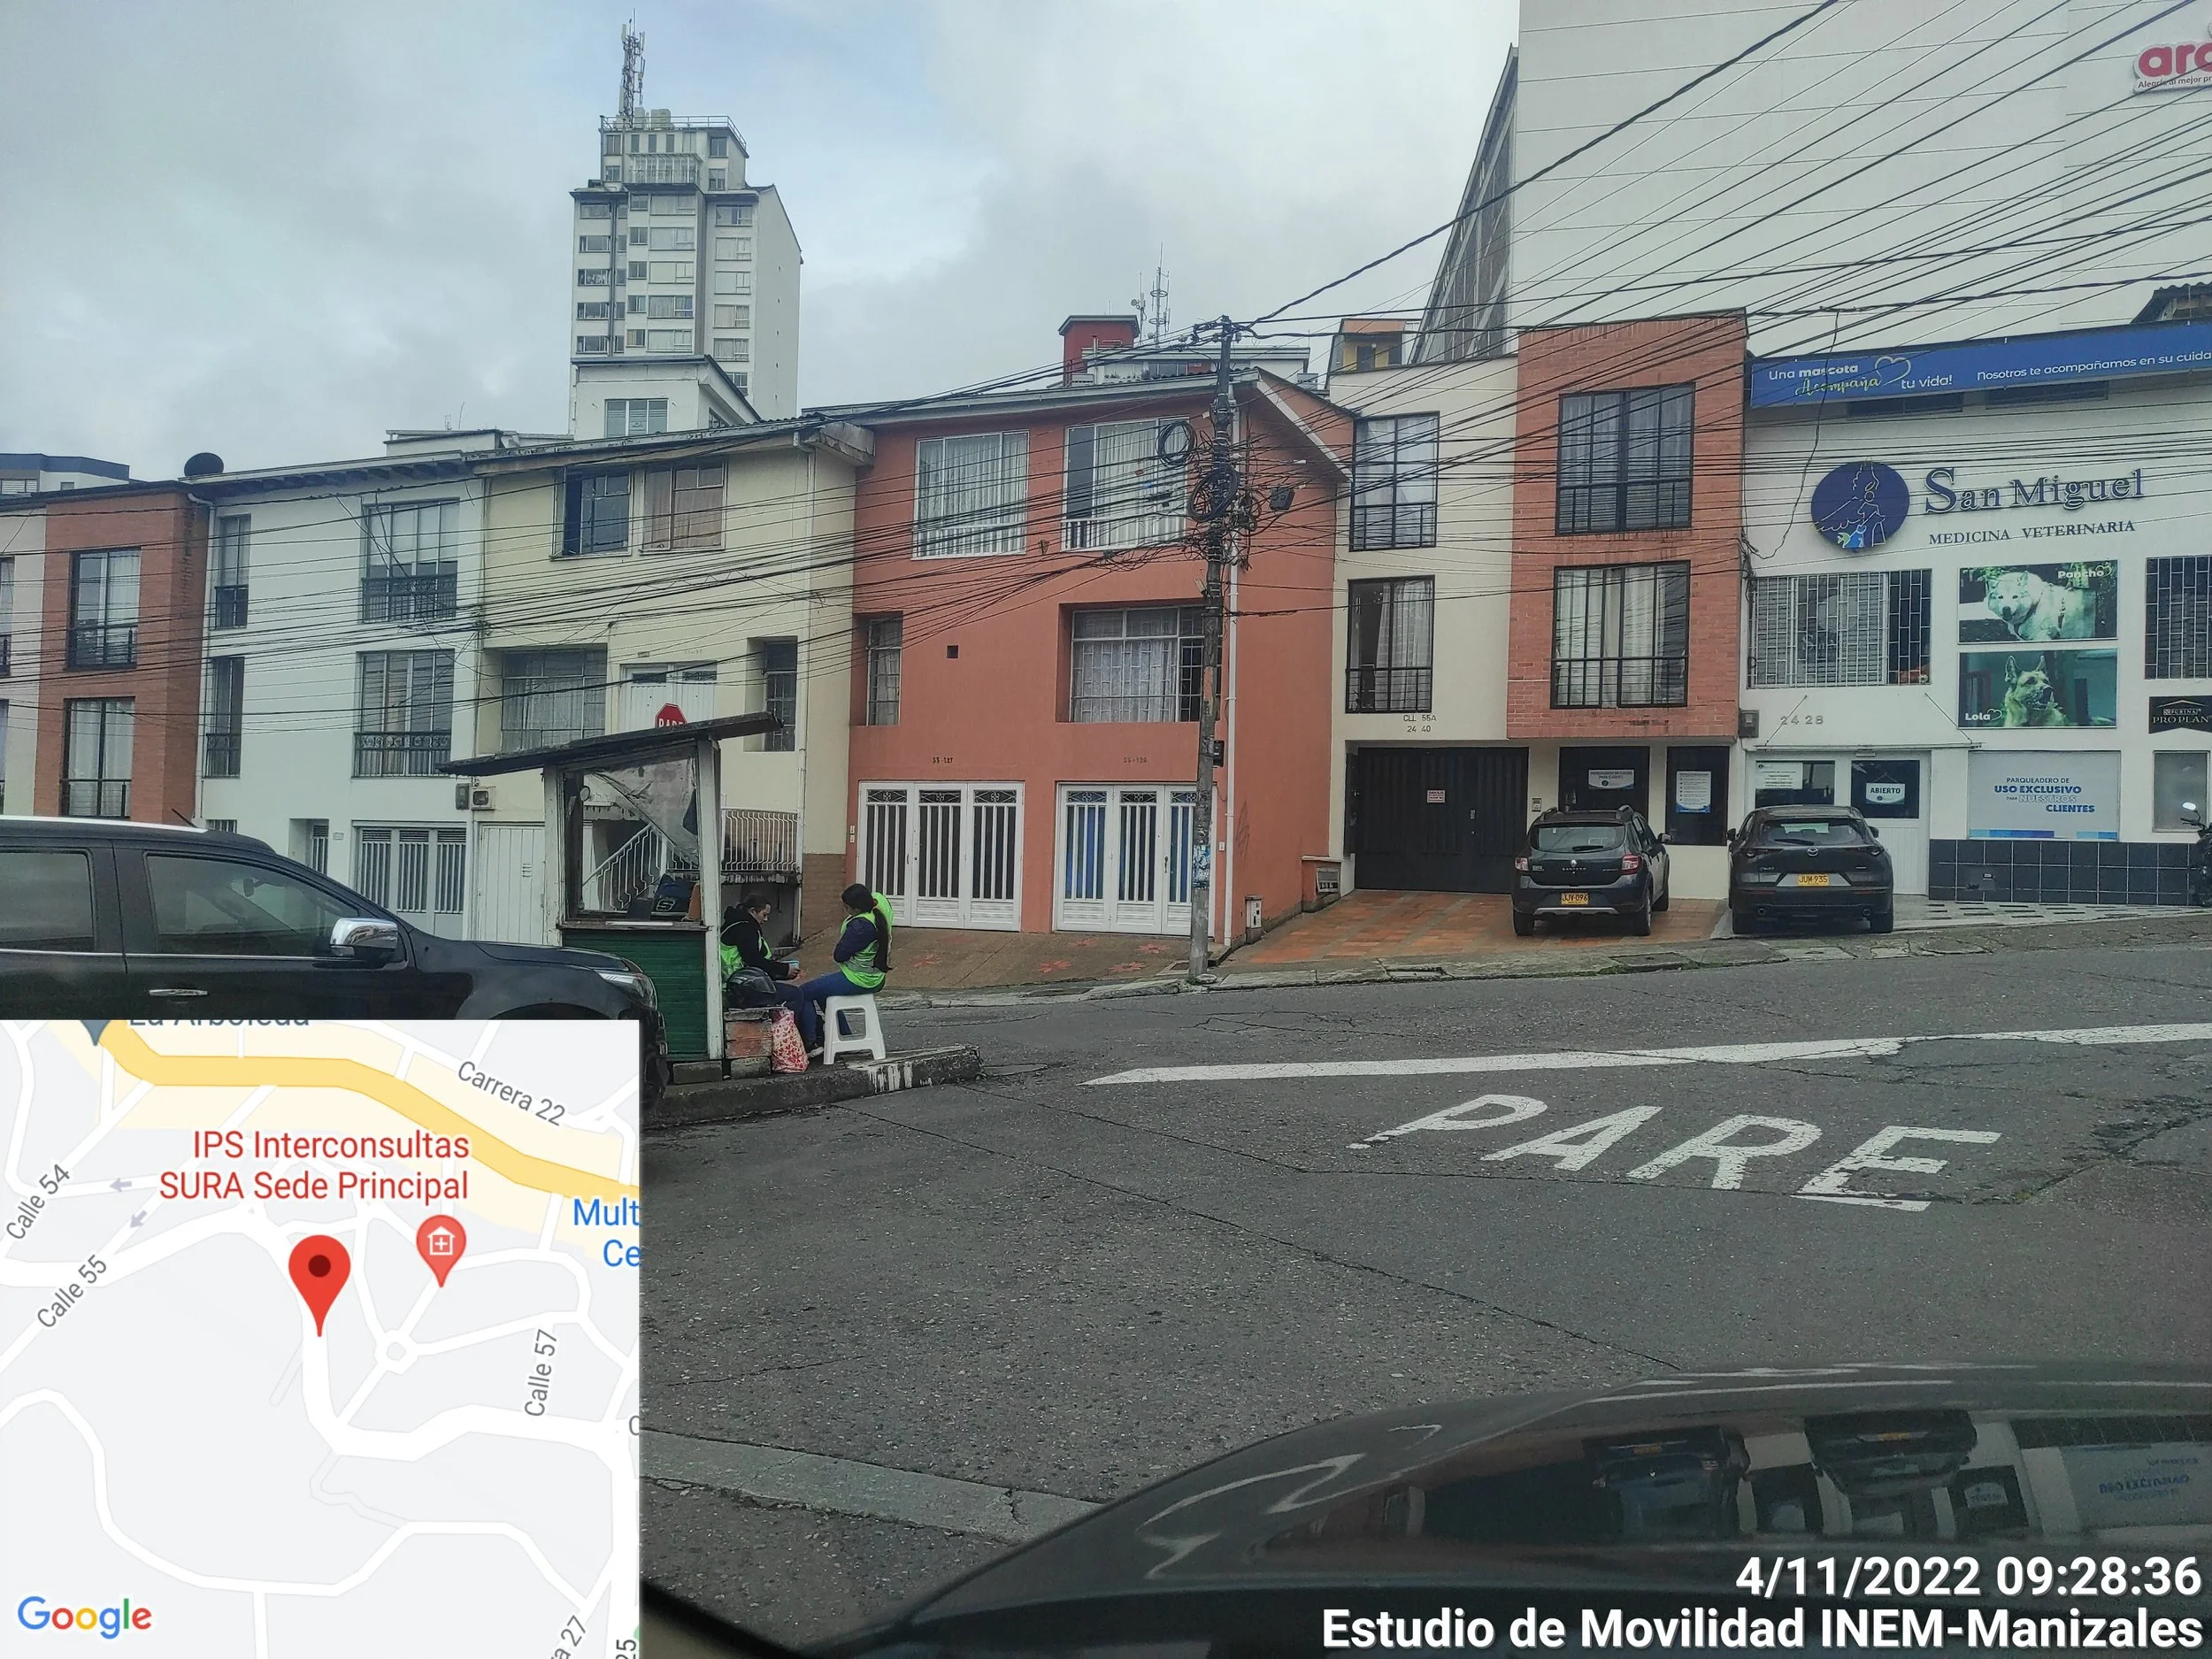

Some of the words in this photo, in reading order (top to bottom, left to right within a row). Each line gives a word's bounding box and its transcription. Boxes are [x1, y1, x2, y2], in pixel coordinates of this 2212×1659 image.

[1769, 370, 1795, 380] Una
[1799, 364, 1859, 378] mascota
[1977, 369, 2027, 380] Nosotros
[2030, 366, 2041, 376] te
[2044, 359, 2137, 374] acompañamos
[2139, 357, 2155, 365] en
[2158, 355, 2173, 364] su
[1901, 378, 1916, 389] tu
[1918, 373, 1954, 388] vida!
[1924, 466, 2002, 514] San
[2008, 467, 2145, 511] Miguel
[1929, 528, 2011, 545] MEDICINA
[2021, 519, 2136, 539] VETERINARIA
[2057, 569, 2105, 580] Pancho
[1964, 711, 1991, 721] Lola
[1994, 785, 2017, 794] USO
[2019, 785, 2082, 795] EXCLUSIVO
[2019, 795, 2078, 803] NUESTROS
[2046, 804, 2095, 813] CLIENTES
[1346, 1094, 2003, 1212] PARE
